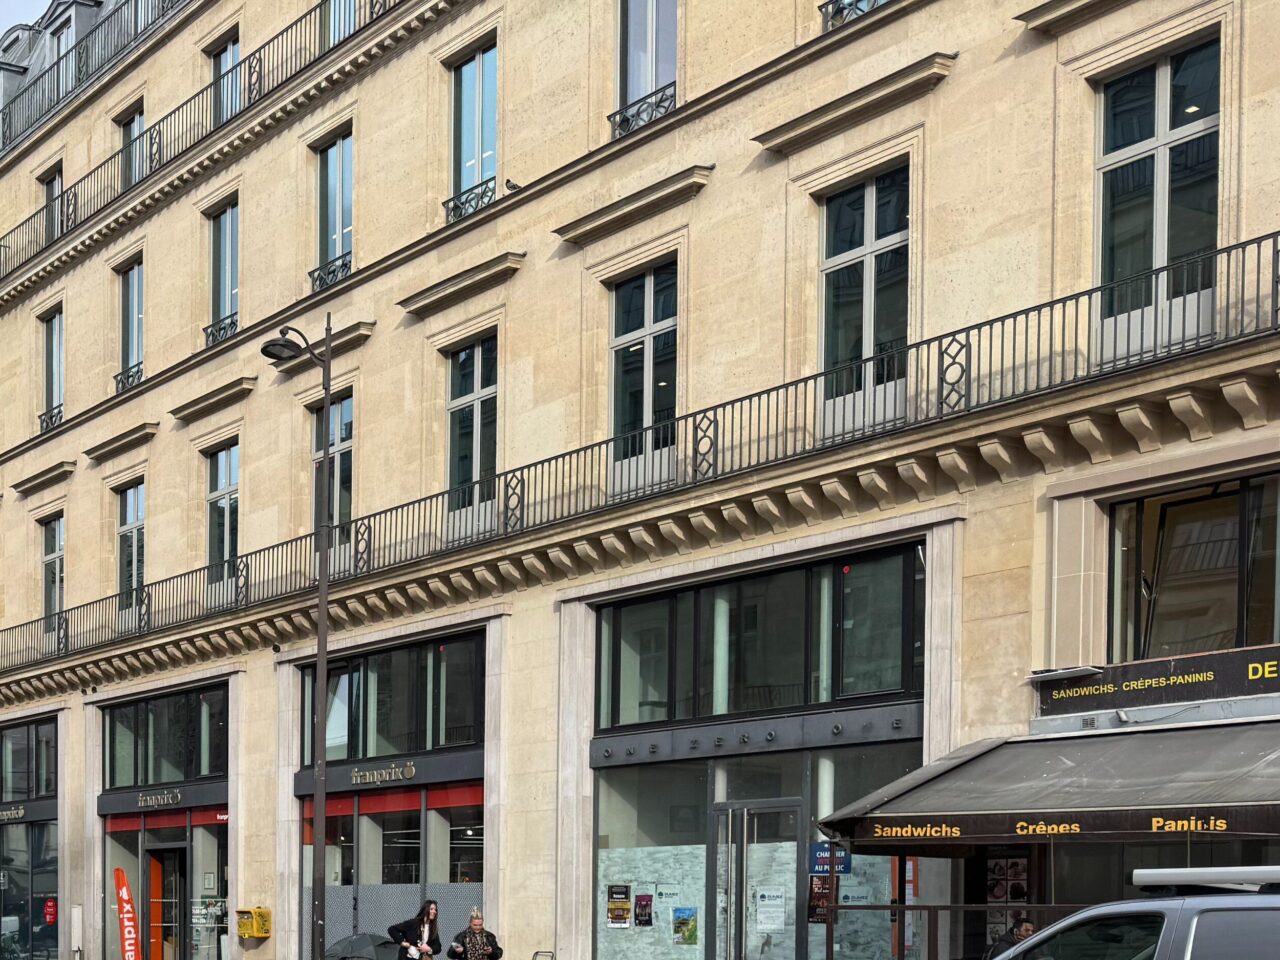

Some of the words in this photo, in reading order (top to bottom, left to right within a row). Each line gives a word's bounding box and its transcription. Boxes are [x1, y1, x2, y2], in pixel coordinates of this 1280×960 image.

[1248, 661, 1278, 680] DE
[831, 719, 903, 735] OE
[351, 763, 403, 786] franprix
[874, 823, 961, 838] Sandwichs
[1016, 820, 1081, 835] Crêpes
[816, 850, 845, 858] CHAIER
[814, 864, 823, 872] AU
[823, 864, 845, 872] PLIC
